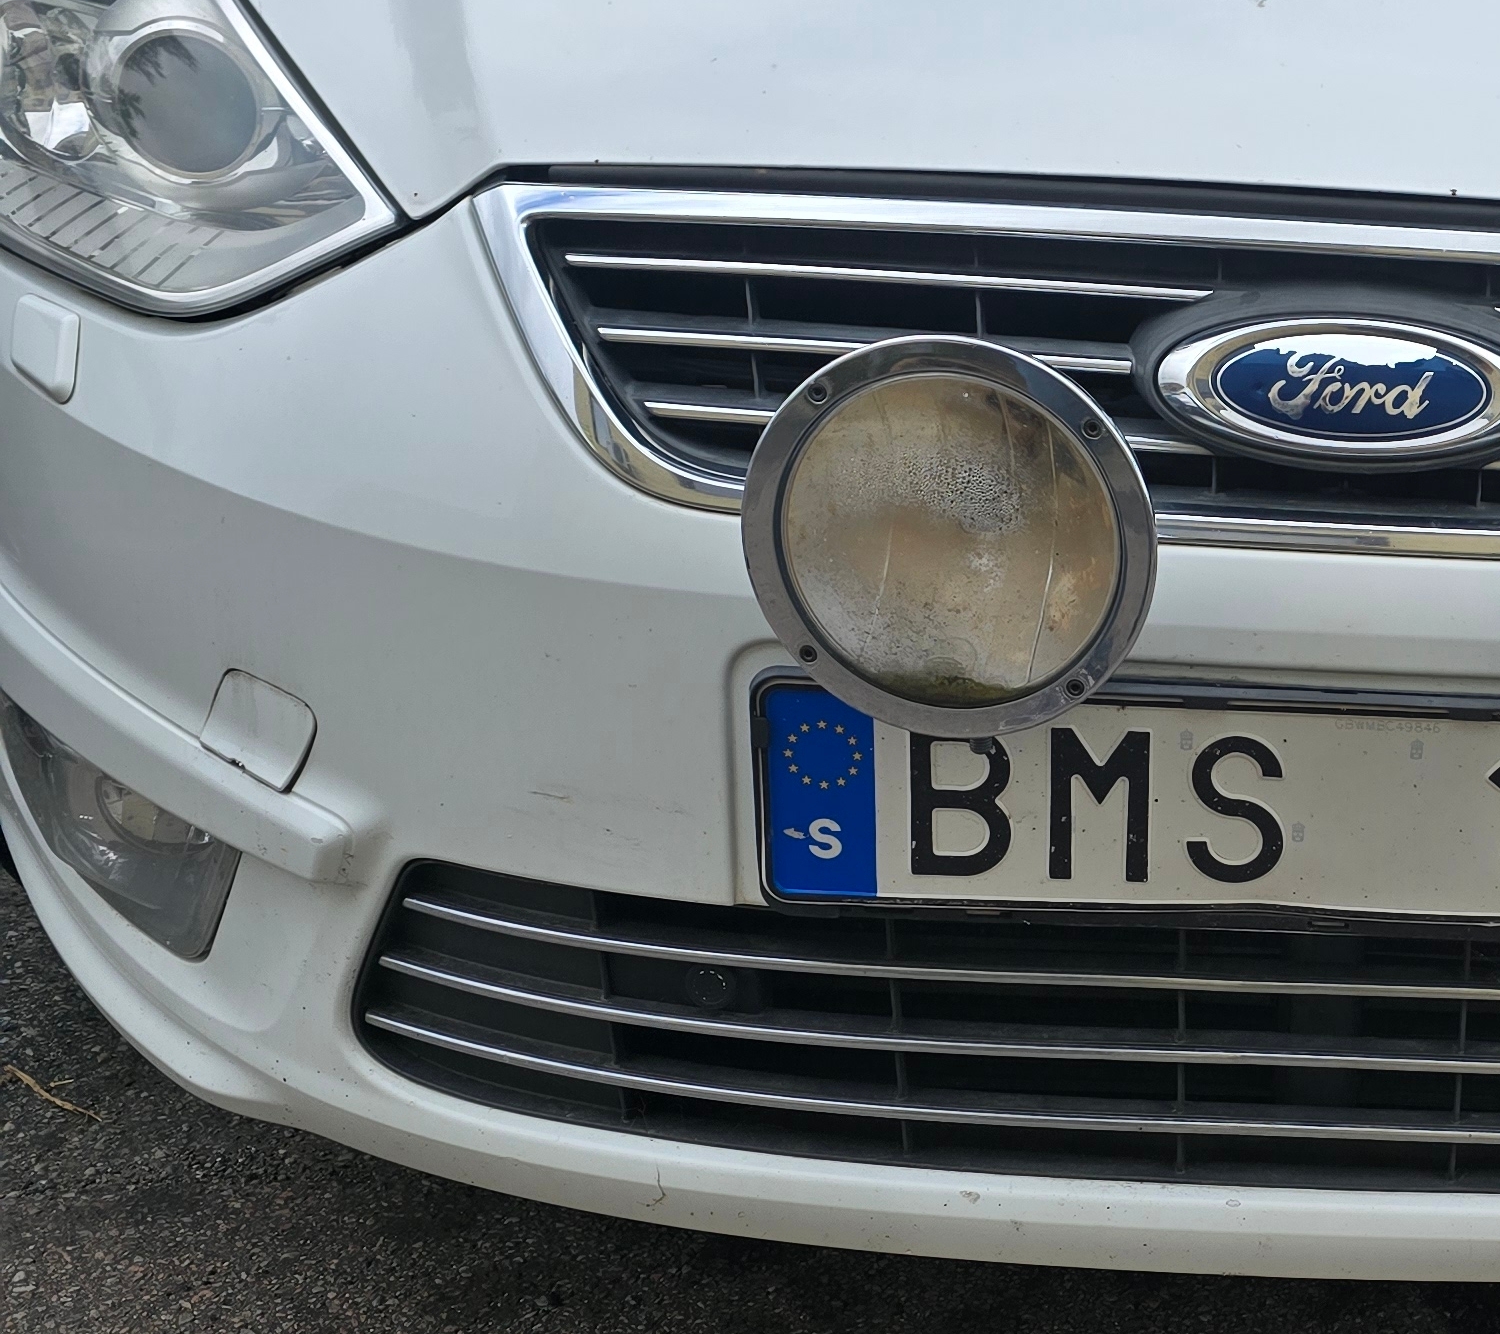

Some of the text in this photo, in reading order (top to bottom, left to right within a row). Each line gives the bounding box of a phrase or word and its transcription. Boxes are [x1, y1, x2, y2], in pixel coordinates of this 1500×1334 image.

[1268, 351, 1434, 420] Ford
[808, 818, 842, 859] S
[910, 728, 1284, 883] BMS
